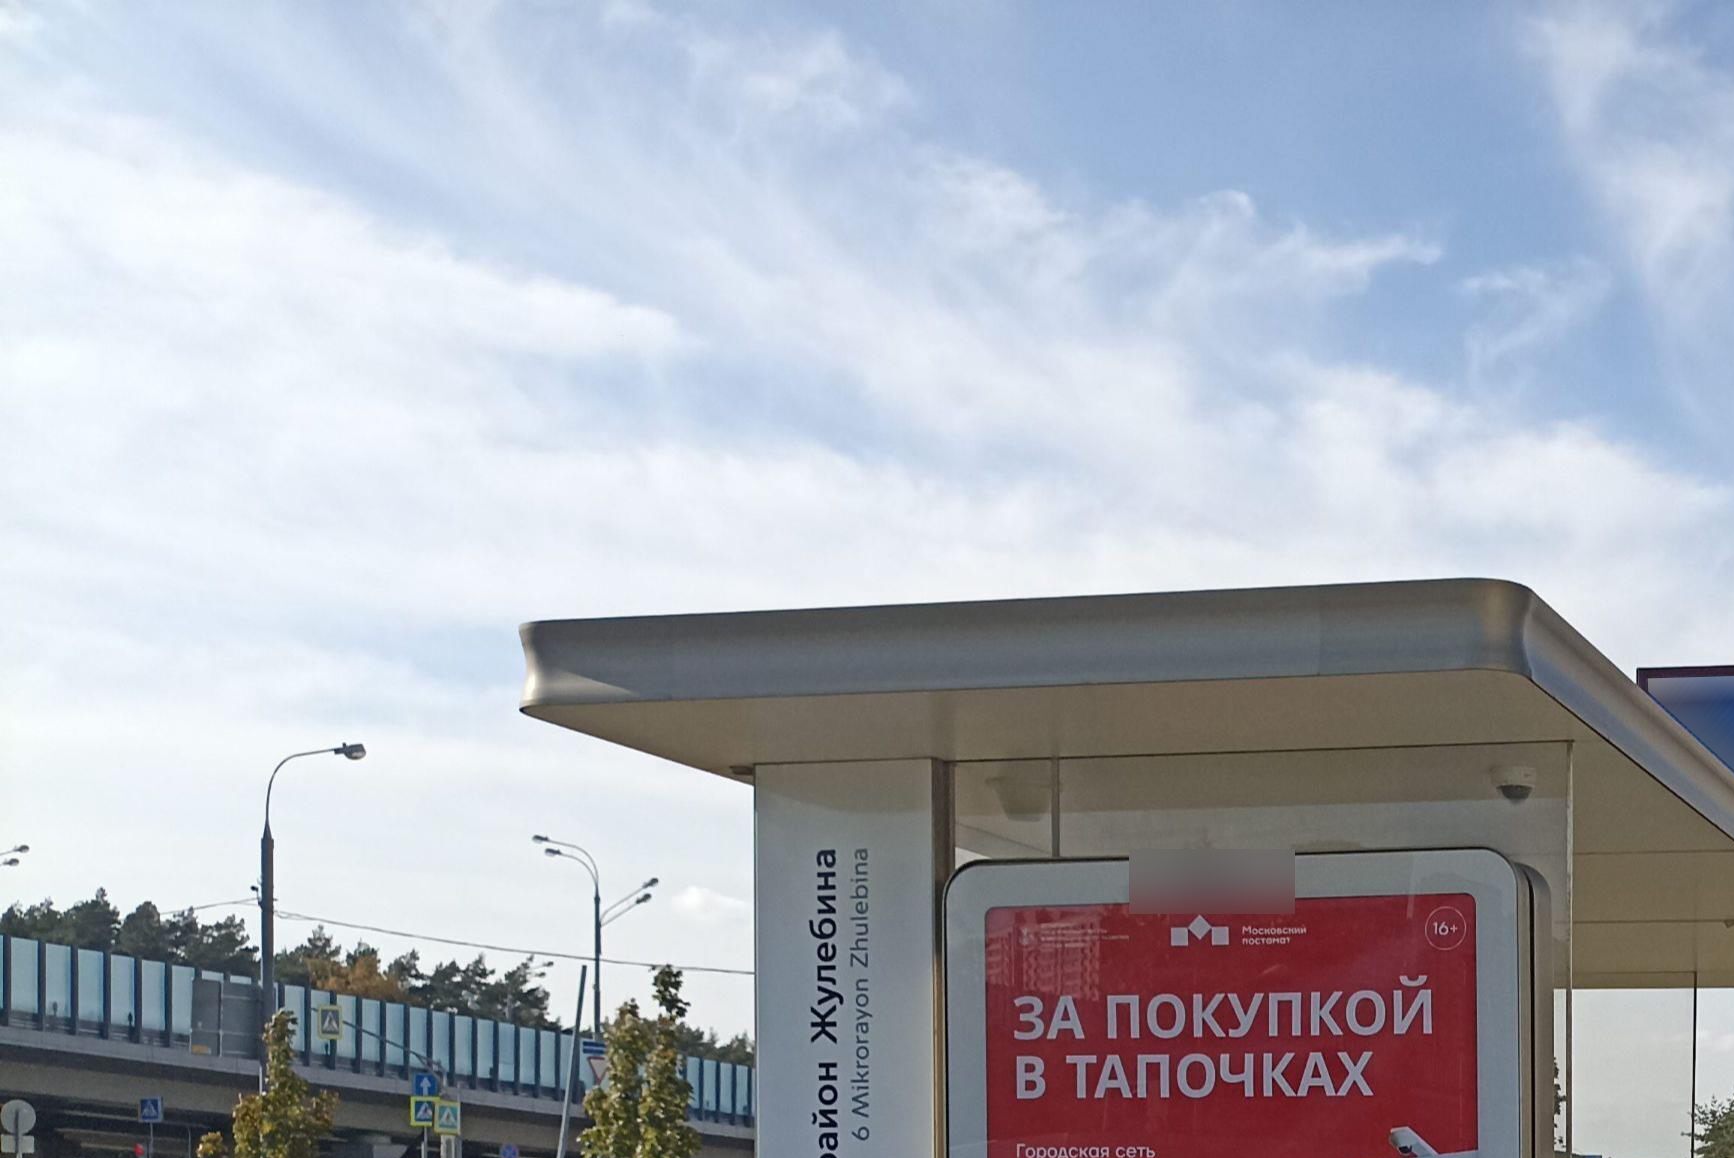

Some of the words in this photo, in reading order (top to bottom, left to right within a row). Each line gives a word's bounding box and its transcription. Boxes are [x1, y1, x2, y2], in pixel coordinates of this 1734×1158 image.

[850, 847, 869, 968] Zhulebina
[1241, 924, 1307, 936] Московский
[1241, 935, 1291, 946] постамат
[1432, 920, 1459, 937] 16+
[808, 848, 844, 1045] Жулебина
[1013, 995, 1086, 1041] ЗА
[1106, 974, 1434, 1041] ПОКУПКОЙ
[850, 977, 873, 1118] Mikrorayon
[1015, 1054, 1047, 1100] В
[1065, 1050, 1374, 1100] ТАПОЧКАХ
[851, 1126, 870, 1141] 6
[1115, 1144, 1156, 1158] сеть
